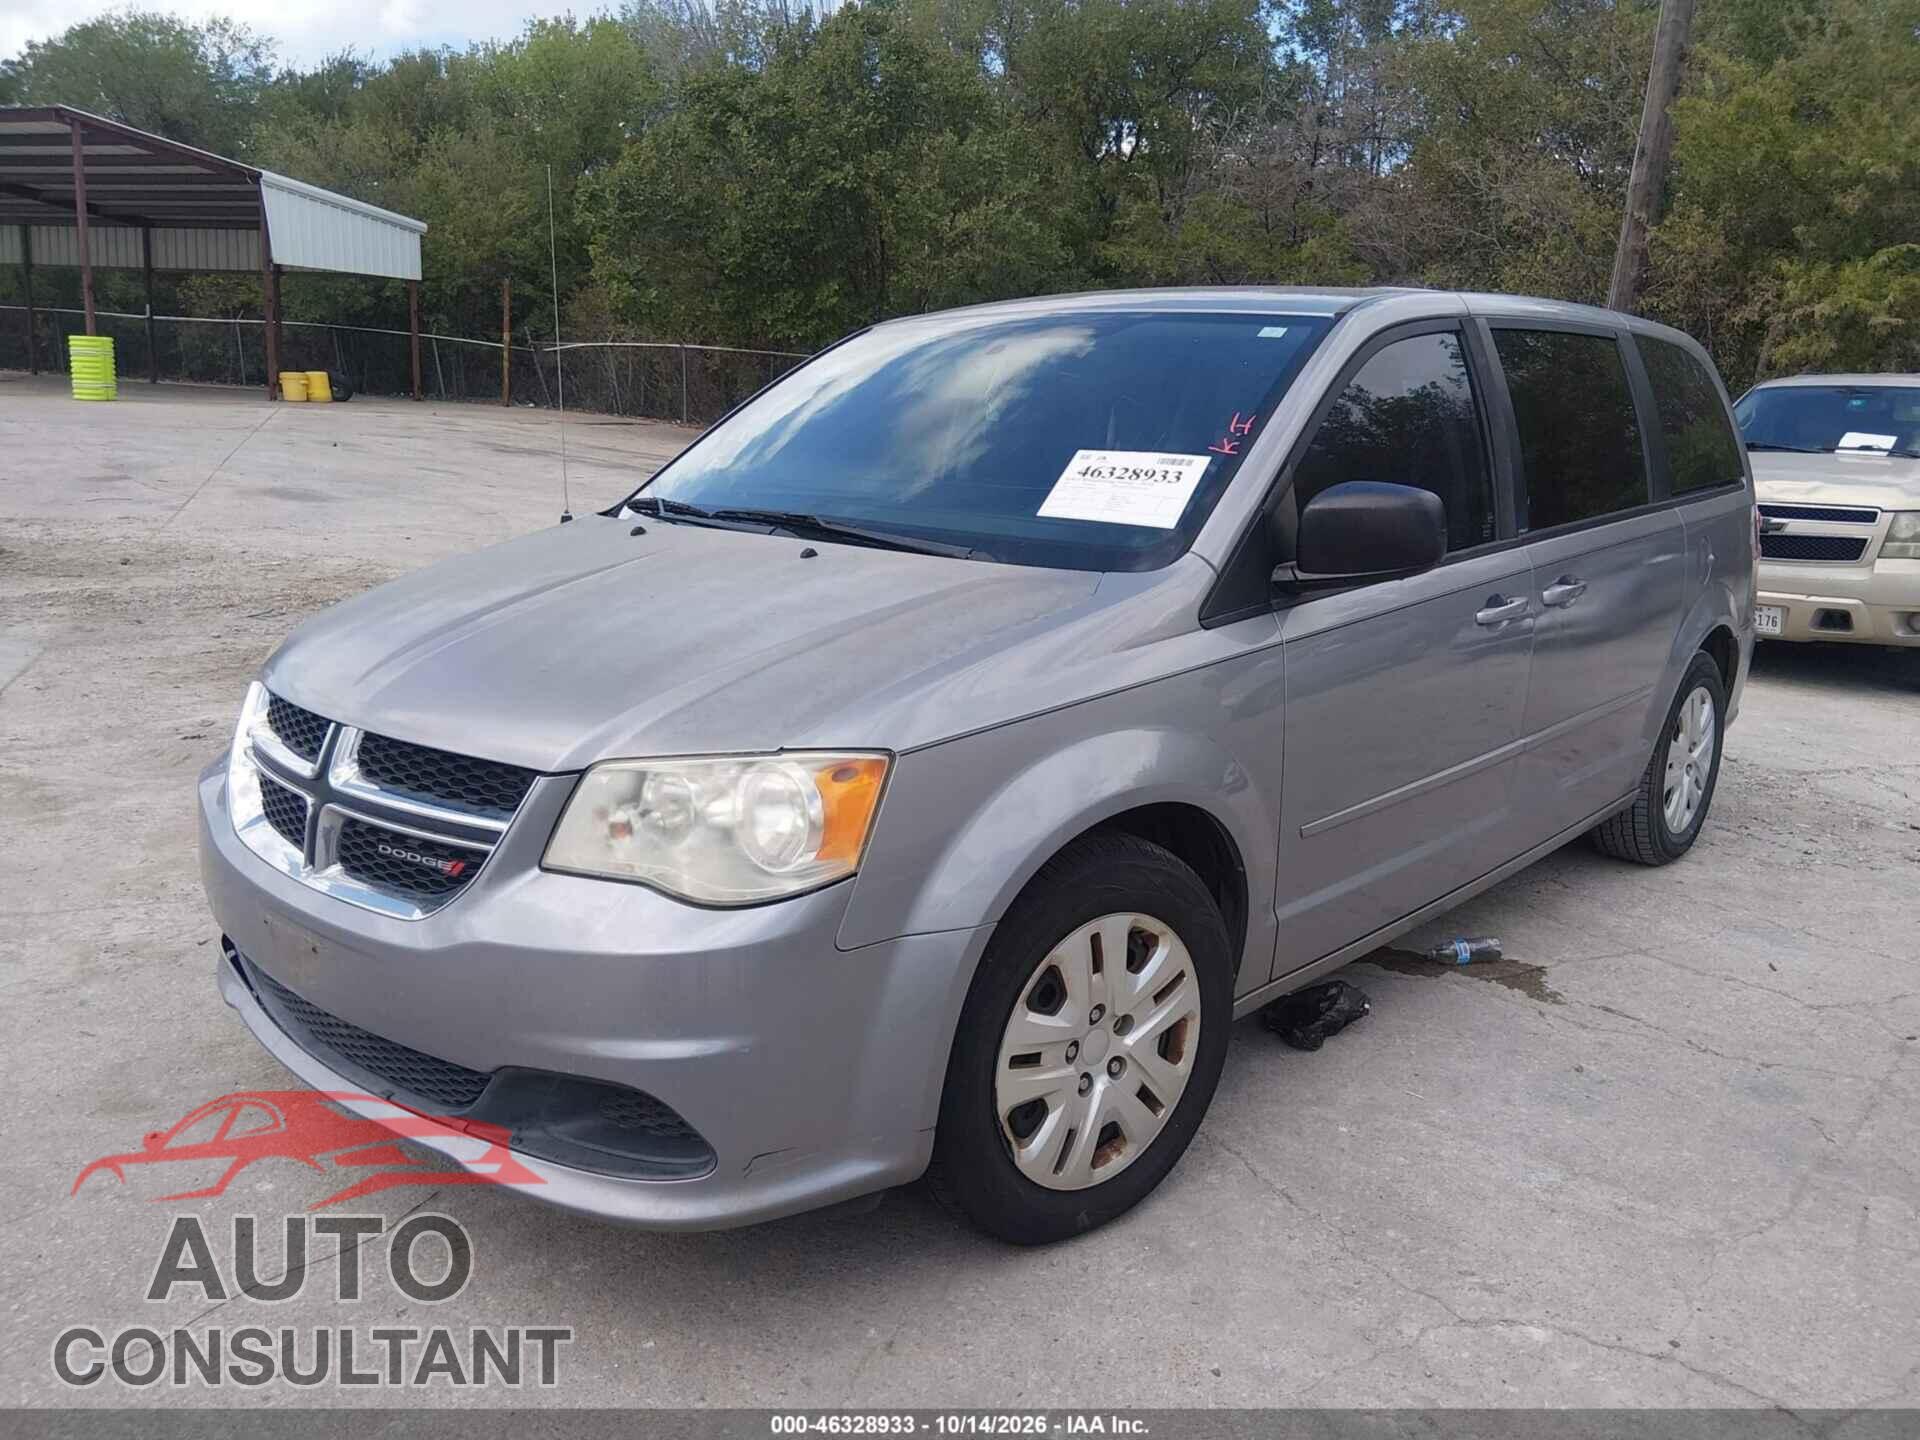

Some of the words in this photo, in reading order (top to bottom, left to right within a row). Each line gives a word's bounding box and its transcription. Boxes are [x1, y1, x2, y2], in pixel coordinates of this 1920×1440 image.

[1077, 465, 1183, 484] 46328933
[1753, 614, 1778, 628] 176
[378, 844, 453, 872] DODGE
